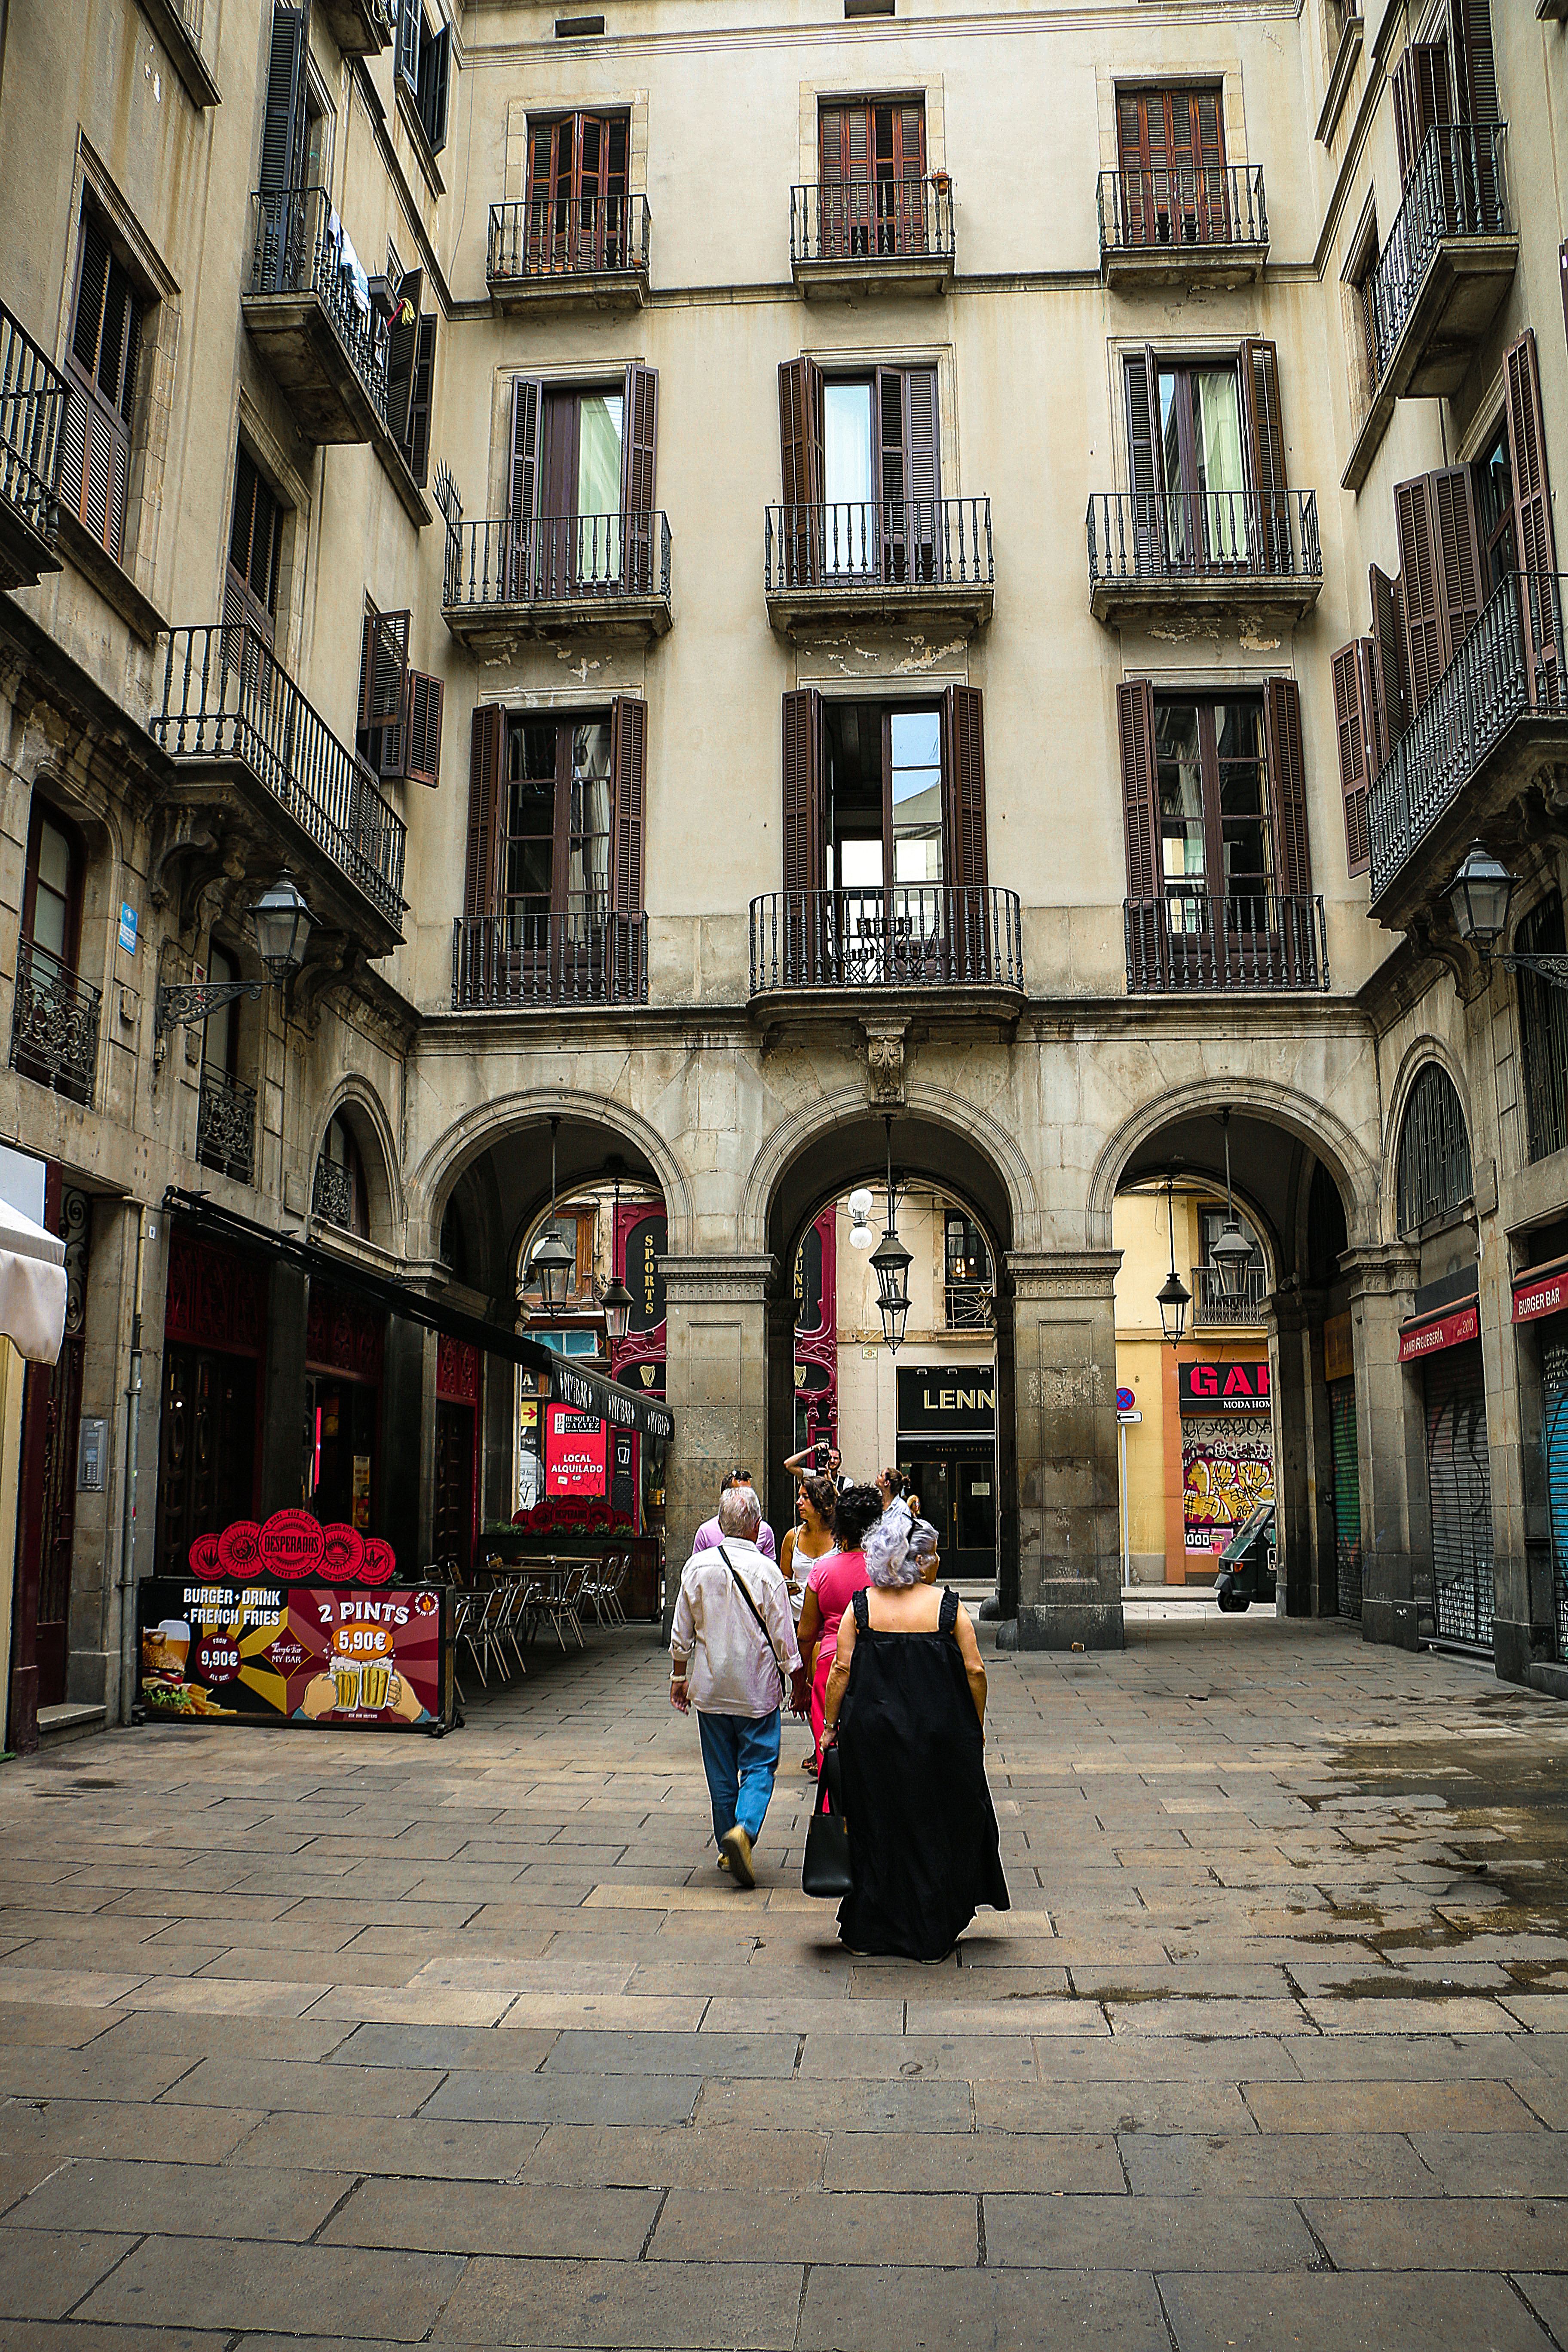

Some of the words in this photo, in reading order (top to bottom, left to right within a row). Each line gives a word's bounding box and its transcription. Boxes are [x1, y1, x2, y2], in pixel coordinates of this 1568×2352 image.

[644, 1235, 654, 1314] SPORTS
[1519, 1293, 1545, 1315] BURGER
[1545, 1287, 1560, 1307] BAR
[564, 1372, 574, 1403] MY
[575, 1378, 587, 1409] BAR
[924, 1390, 995, 1409] LENN
[612, 1394, 620, 1421] MY
[621, 1399, 631, 1425] BAR
[563, 1454, 592, 1463] LOCAL
[551, 1464, 603, 1473] ALQUILADO
[265, 1535, 318, 1553] DESPERADOS
[184, 1588, 233, 1604] BURGER
[242, 1590, 281, 1605] DRINK
[190, 1608, 239, 1624] FRENCH
[243, 1610, 280, 1626] FRIES
[318, 1604, 333, 1623] 2
[340, 1601, 410, 1624] PINTS
[271, 1642, 291, 1656] Temple
[339, 1631, 386, 1654] 5,90€
[201, 1650, 238, 1668] 9,90€
[285, 1655, 301, 1663] BAR
